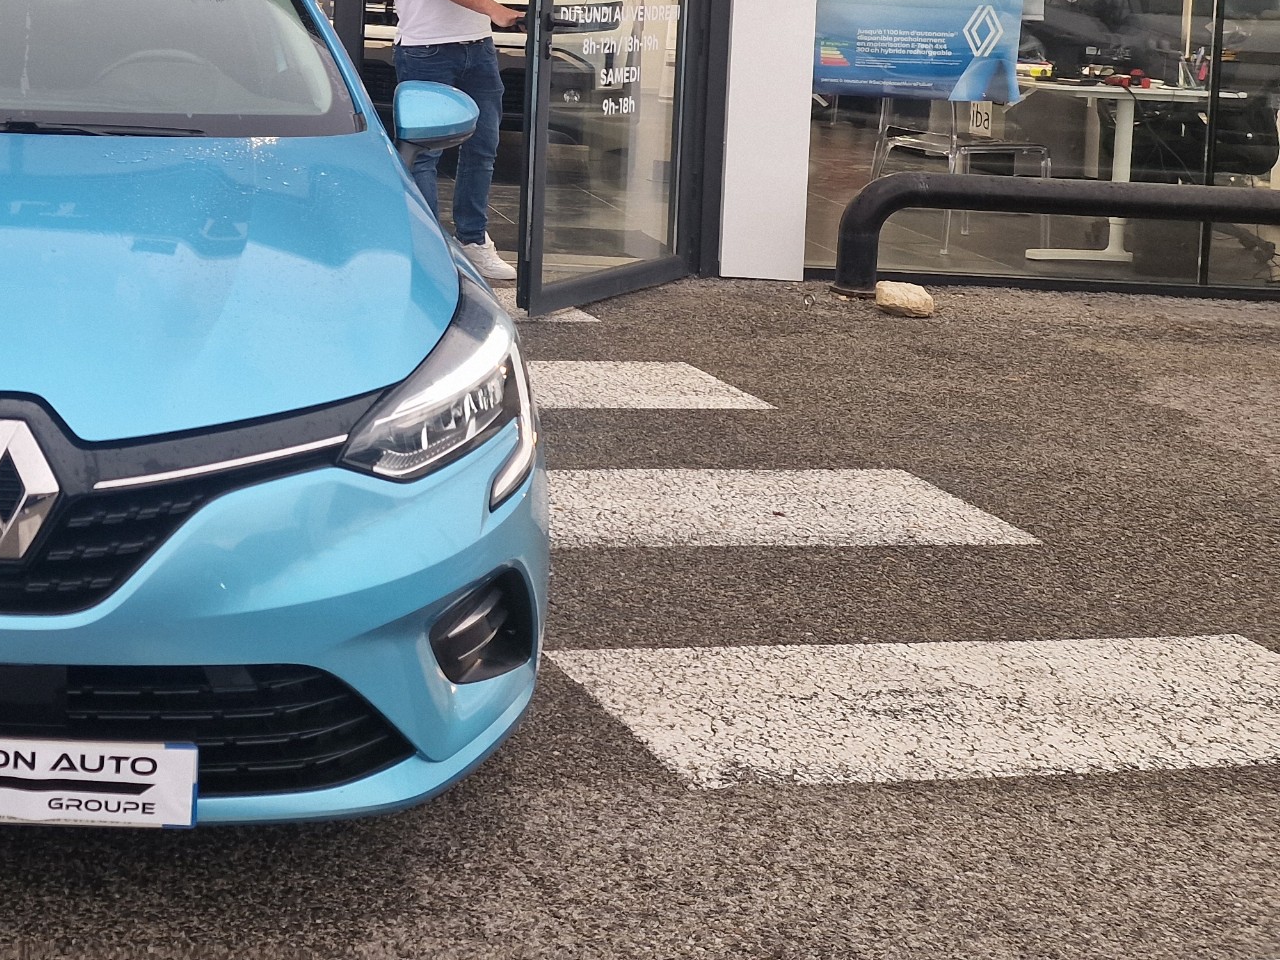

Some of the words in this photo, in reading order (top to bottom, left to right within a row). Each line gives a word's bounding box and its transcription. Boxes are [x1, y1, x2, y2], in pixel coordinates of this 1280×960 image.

[578, 6, 612, 24] LUNDI
[582, 35, 617, 56] 8h-12h
[600, 66, 640, 86] SAMEDI
[602, 96, 636, 116] 9h-18h
[48, 751, 159, 776] AUTO
[47, 797, 157, 815] GROUPE
